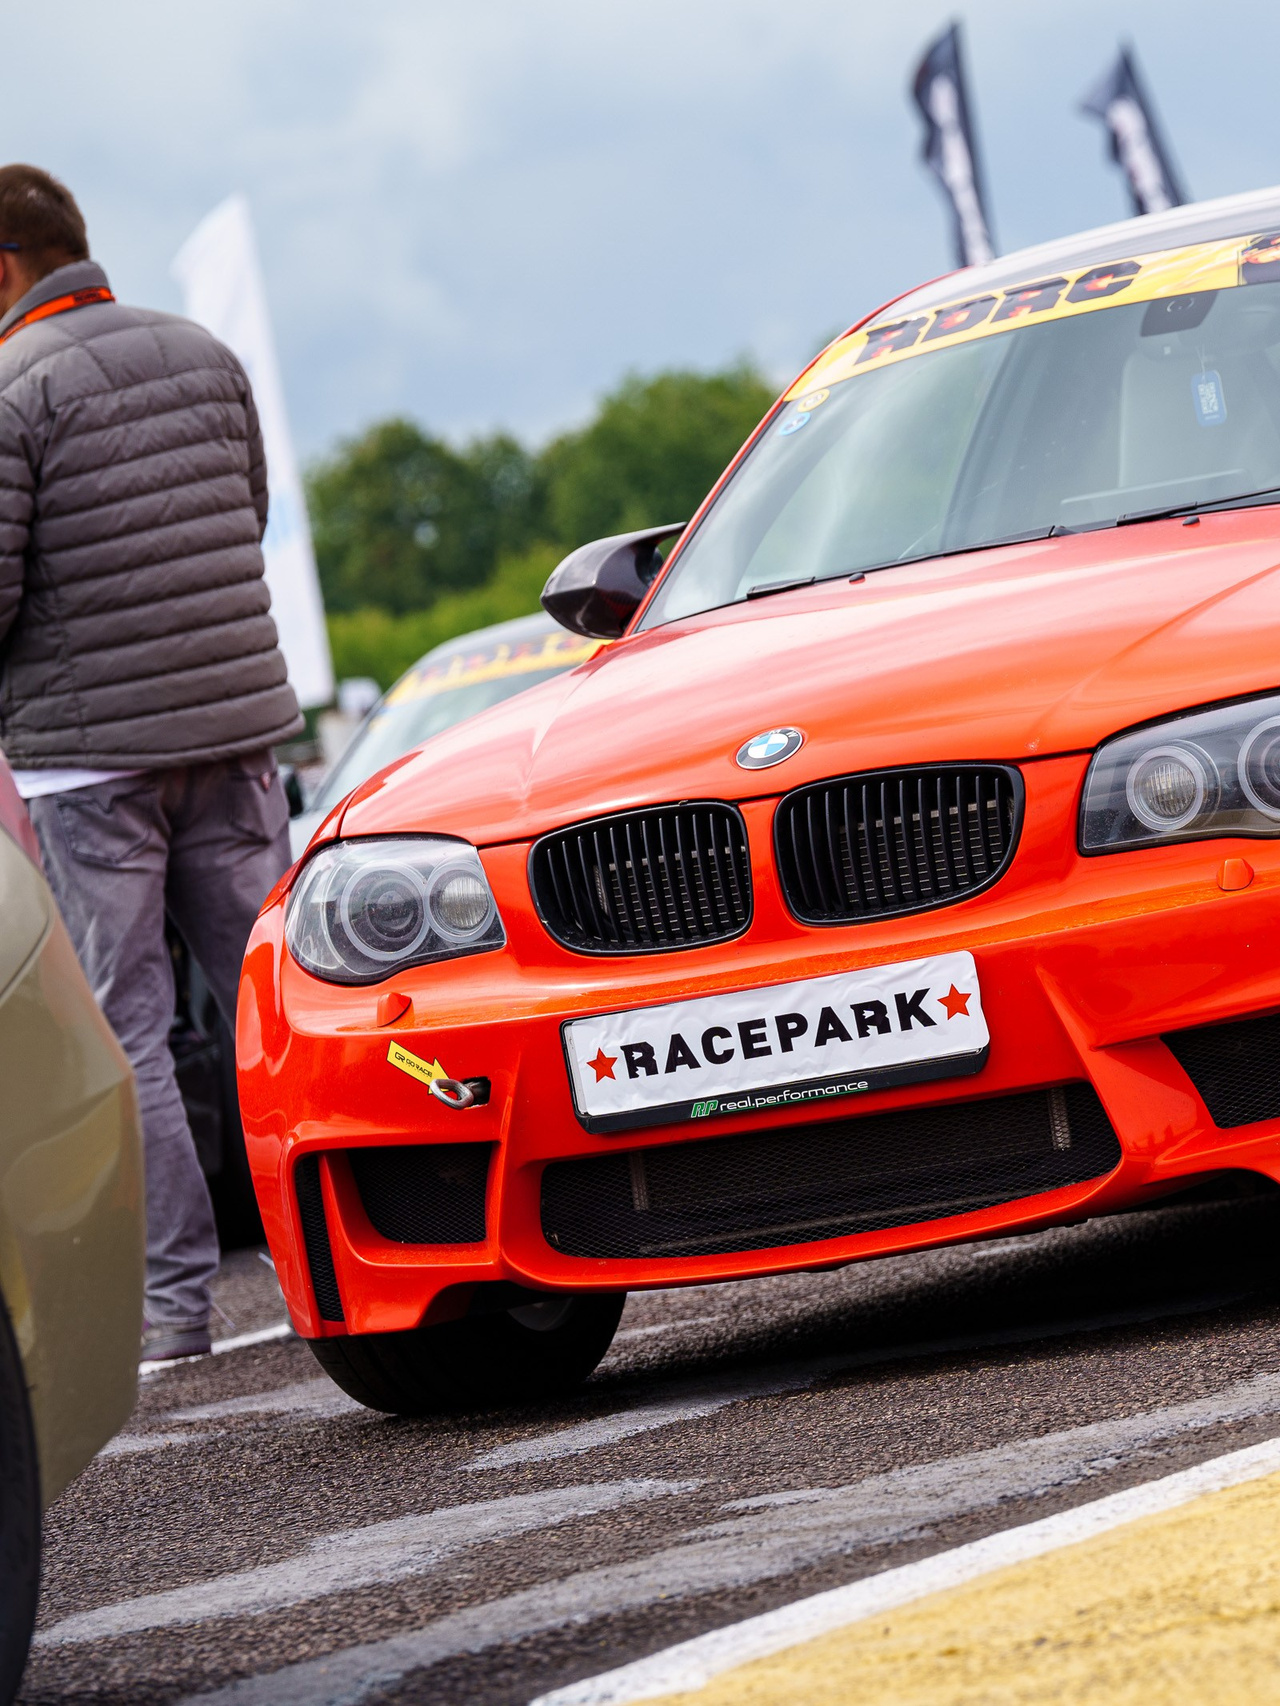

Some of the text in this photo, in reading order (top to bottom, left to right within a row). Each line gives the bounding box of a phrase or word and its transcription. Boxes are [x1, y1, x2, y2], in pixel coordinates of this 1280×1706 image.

[854, 260, 1142, 366] RDRC
[620, 987, 937, 1080] RACEPARK
[720, 1080, 868, 1108] real.performance
